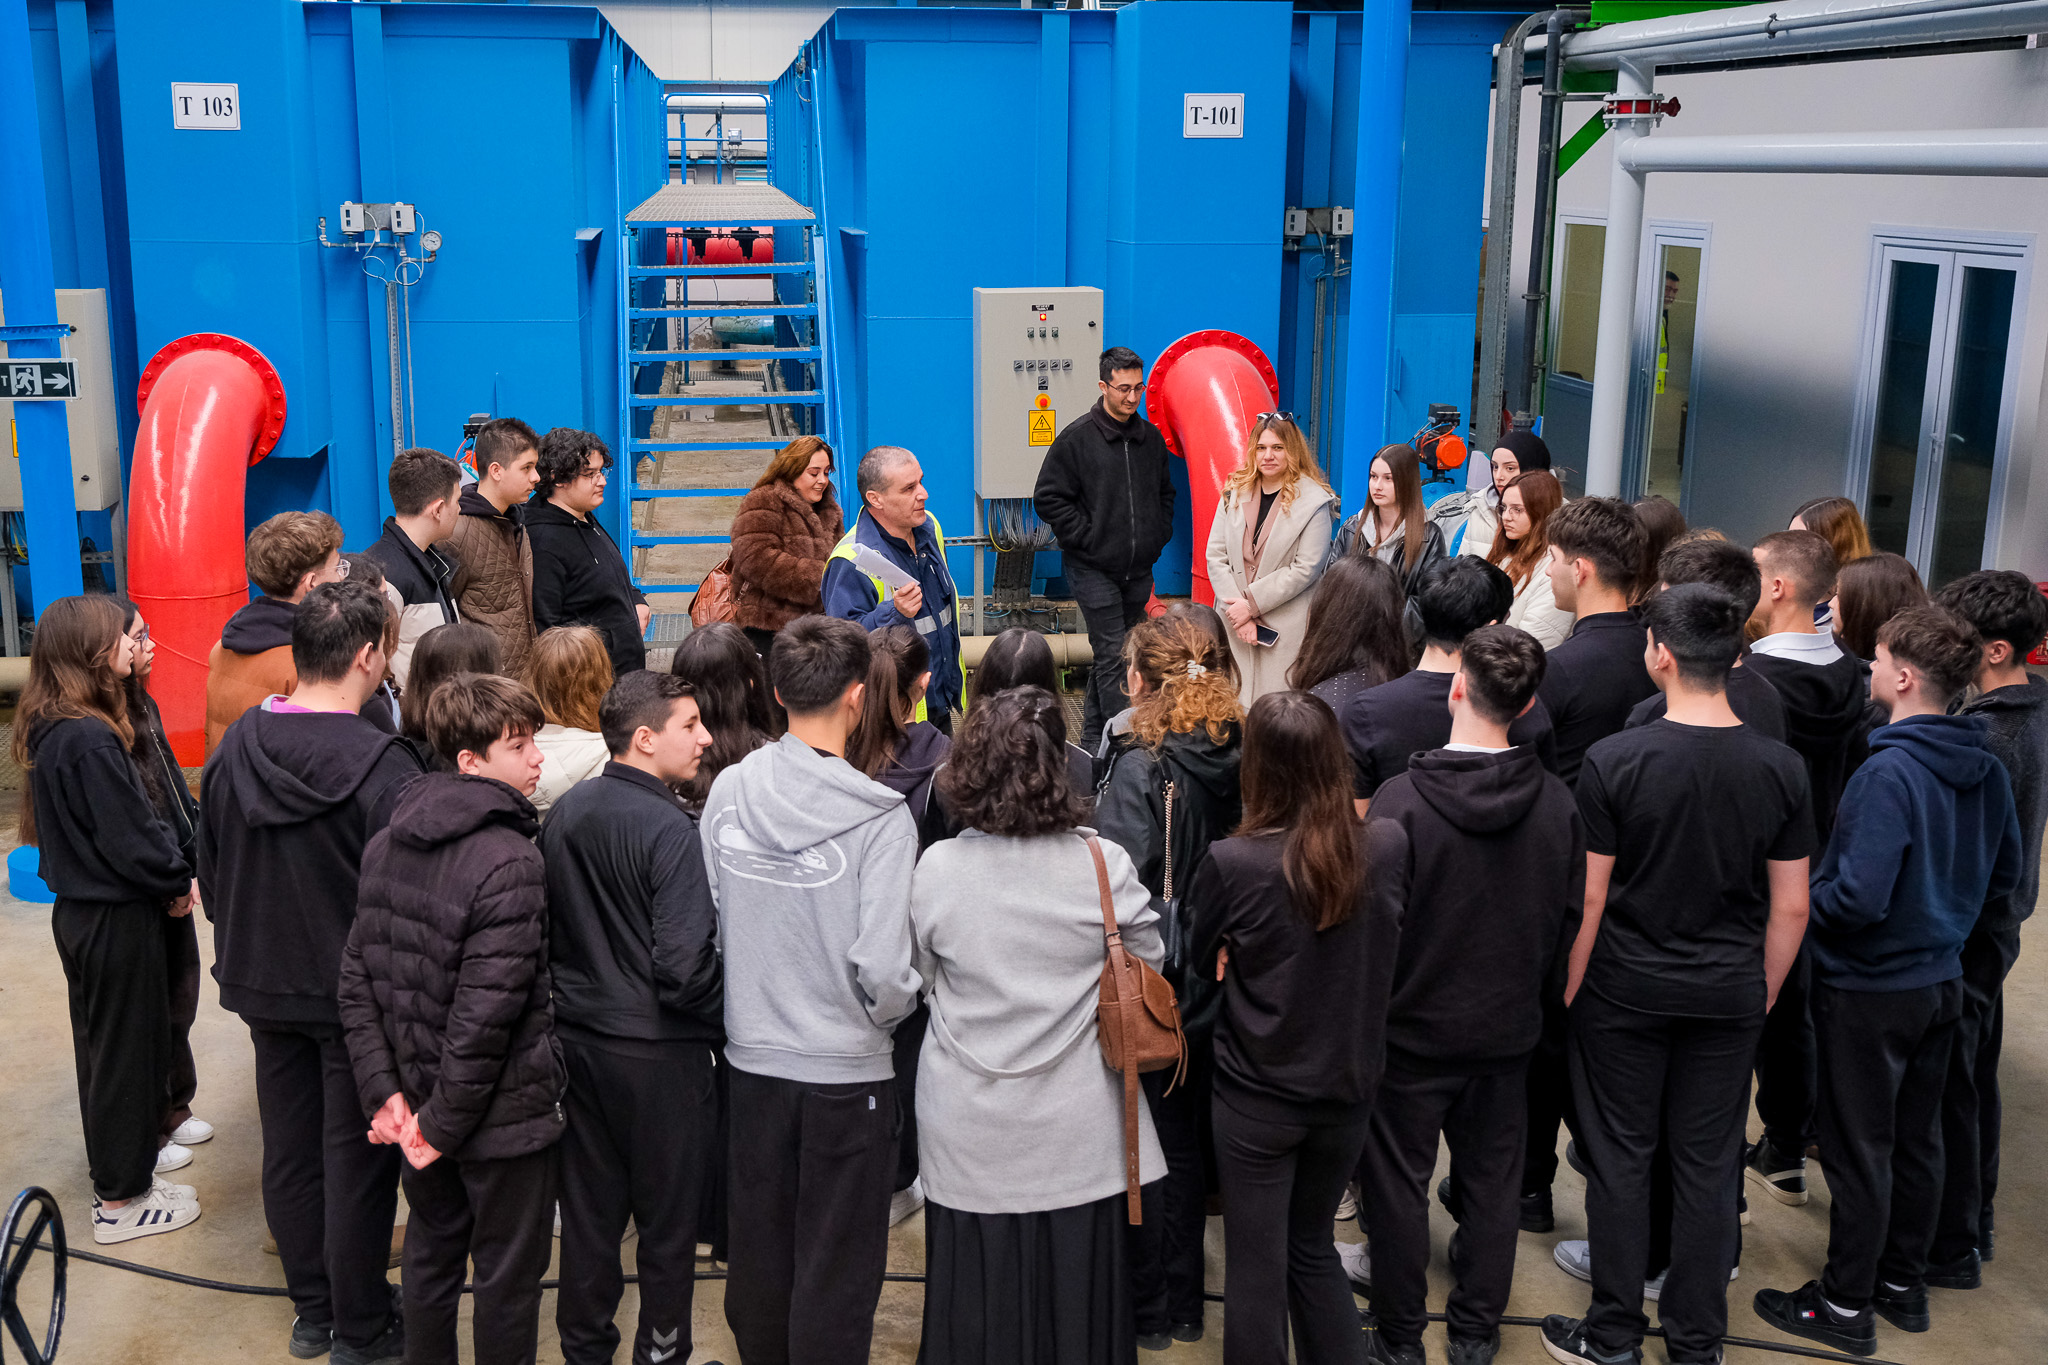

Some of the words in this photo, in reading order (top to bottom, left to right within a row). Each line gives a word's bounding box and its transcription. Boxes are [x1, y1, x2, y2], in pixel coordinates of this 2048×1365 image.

[179, 96, 193, 116] T
[203, 96, 233, 117] 103
[1190, 106, 1237, 125] T-101
